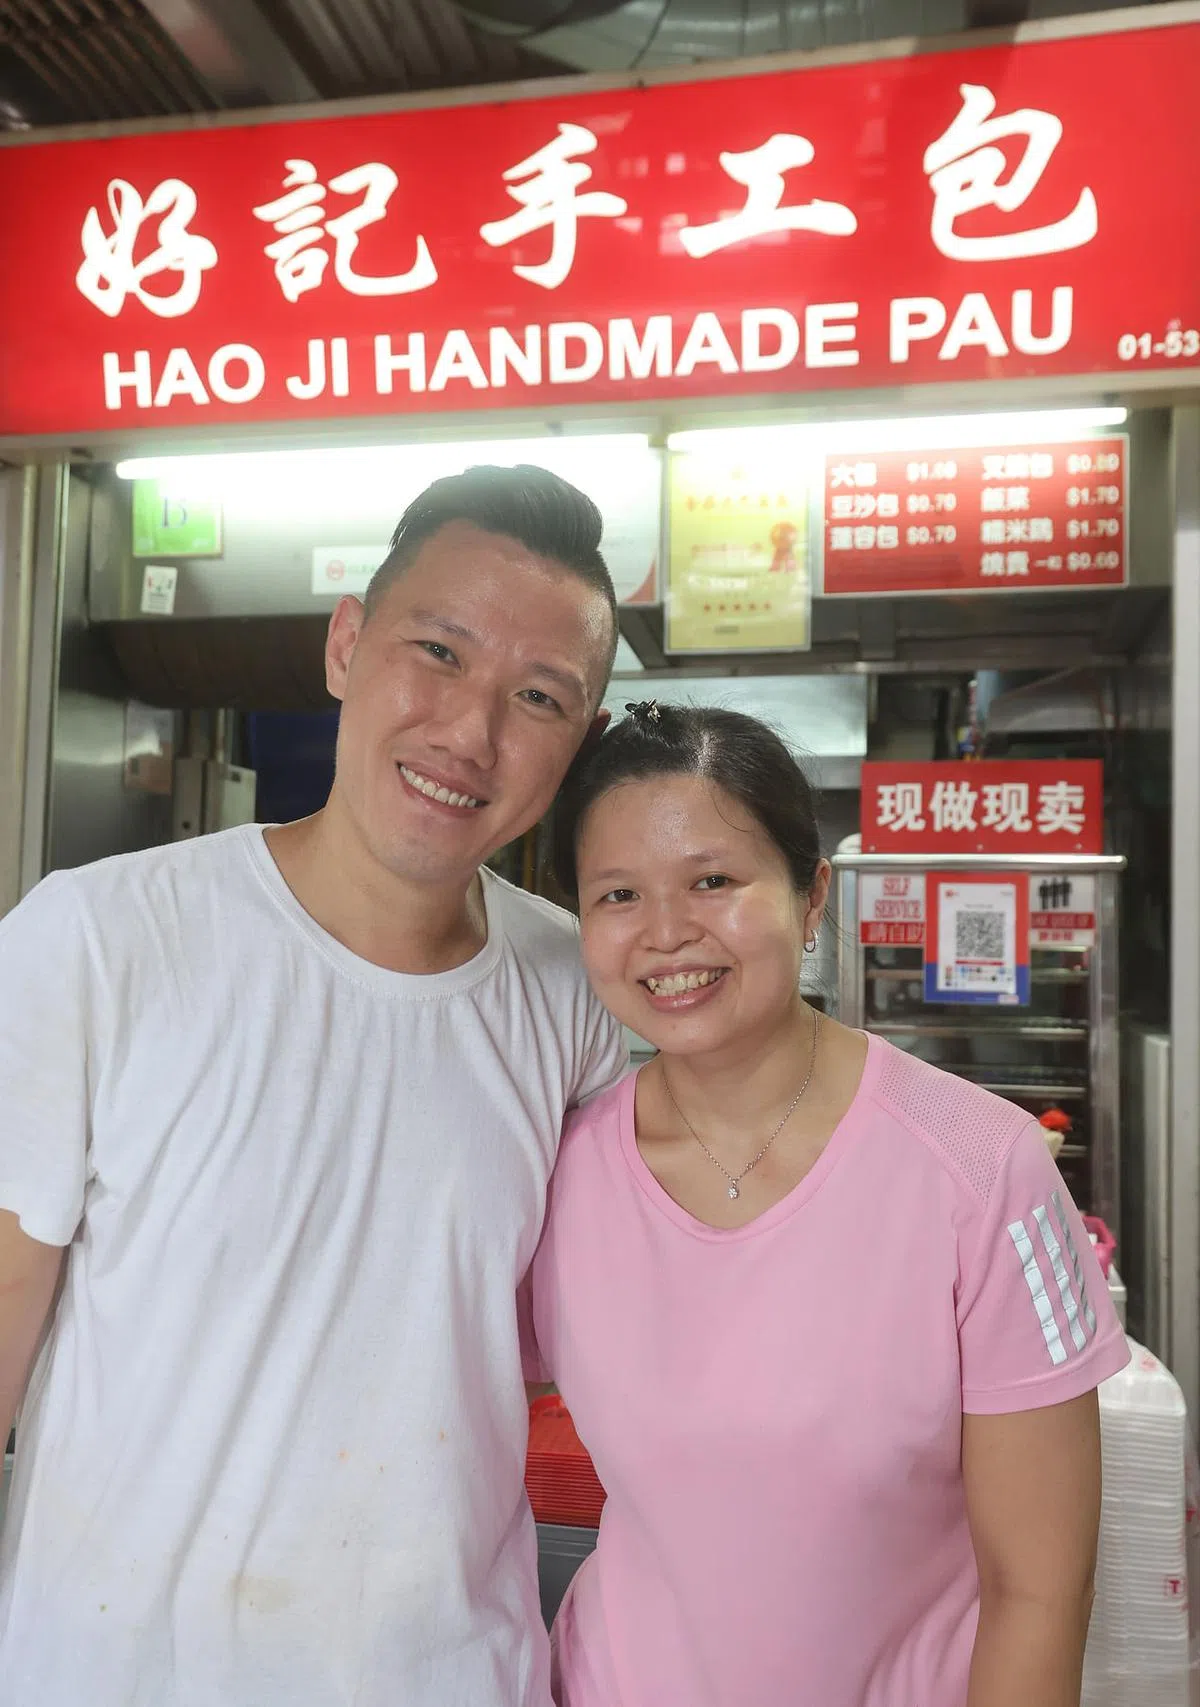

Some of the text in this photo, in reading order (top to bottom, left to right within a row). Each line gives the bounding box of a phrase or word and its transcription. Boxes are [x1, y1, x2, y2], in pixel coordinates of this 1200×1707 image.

[104, 287, 1073, 410] HAO JI HANDMADE PAU
[876, 781, 1085, 834] 现做现卖
